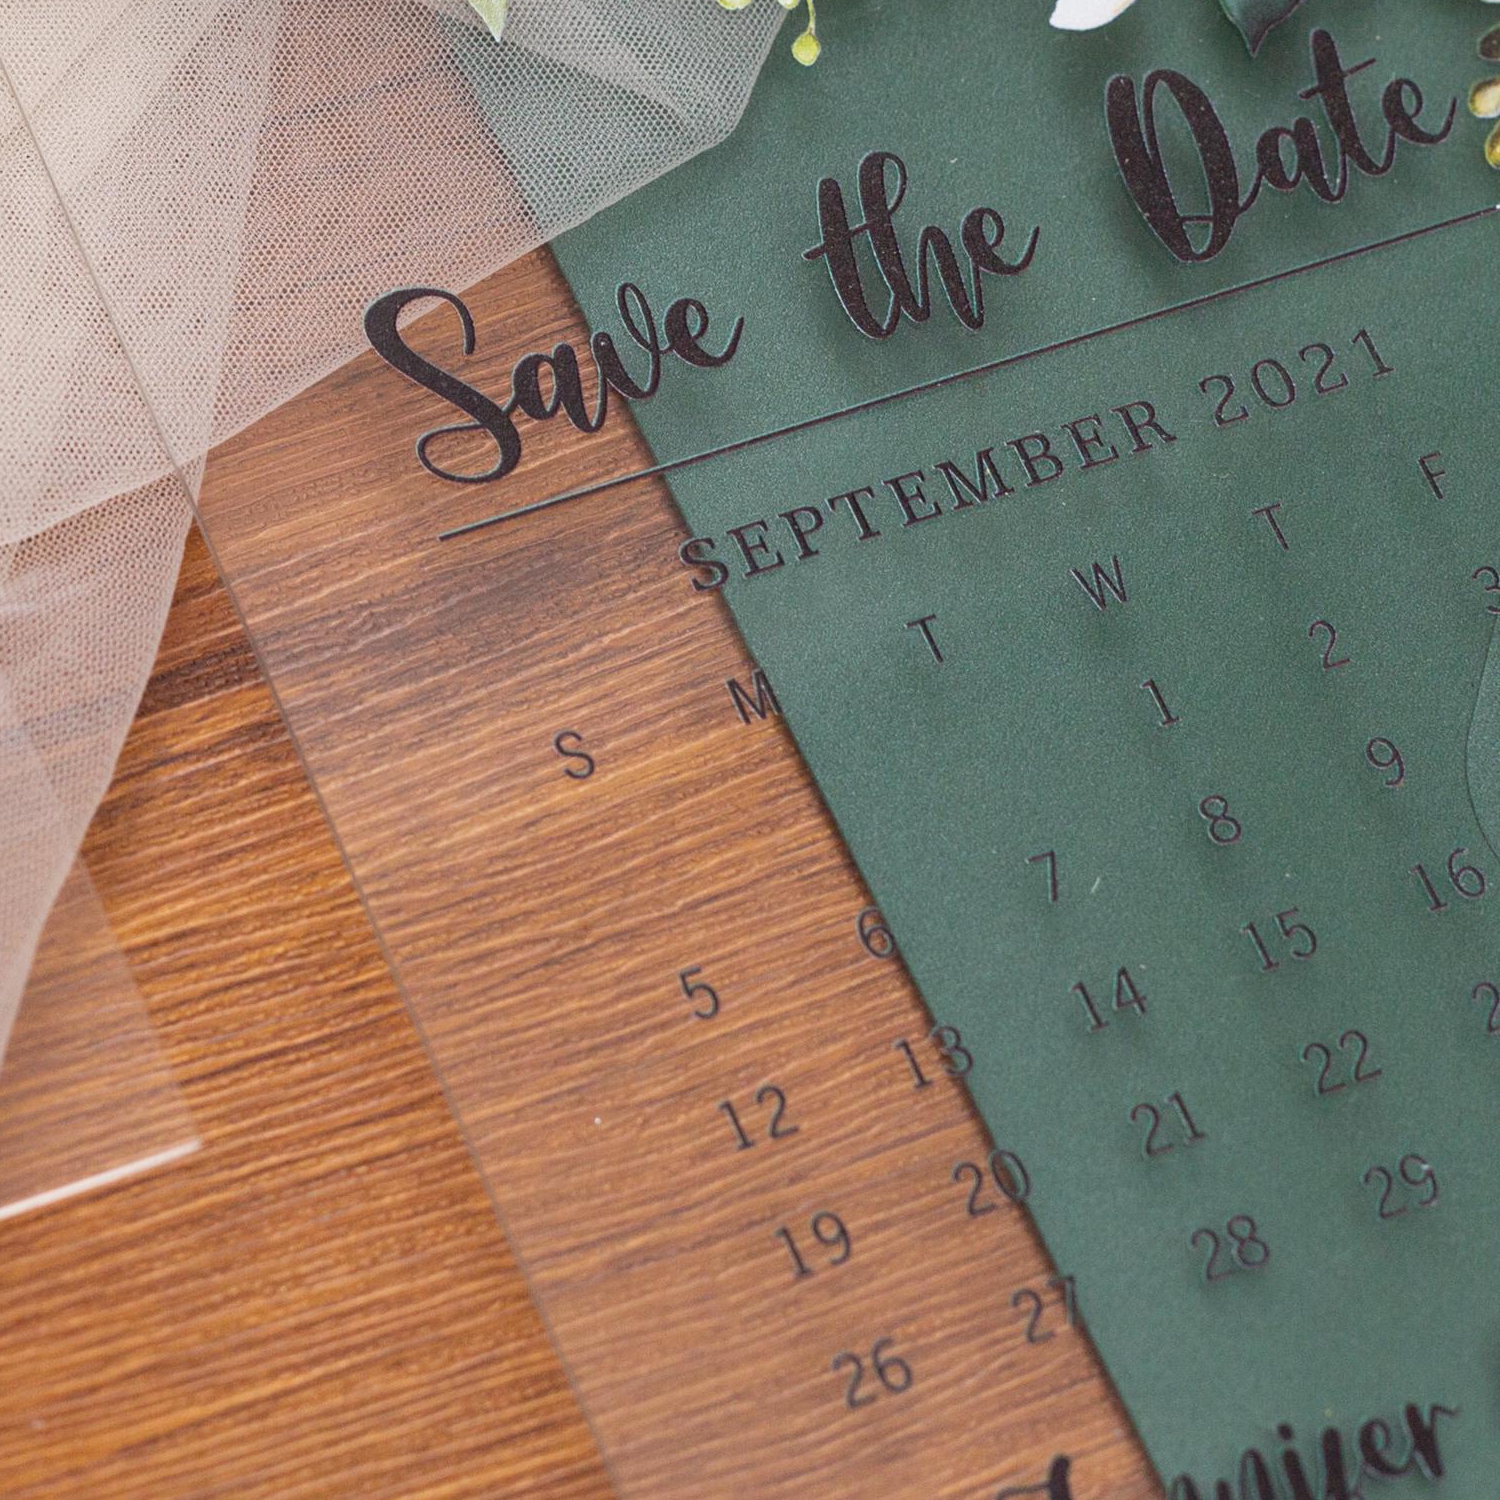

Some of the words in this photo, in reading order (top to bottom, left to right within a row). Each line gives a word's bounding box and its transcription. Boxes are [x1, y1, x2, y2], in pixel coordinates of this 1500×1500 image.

[363, 282, 744, 483] Save
[802, 151, 1040, 340] the
[1105, 27, 1458, 263] Date
[678, 400, 1177, 592] SEPTEMBER
[1199, 326, 1395, 428] 2021
[553, 730, 595, 779] S
[724, 668, 783, 725] M
[905, 614, 944, 664] T
[1069, 554, 1128, 612] W
[1251, 502, 1289, 551] T
[1416, 452, 1447, 500] F
[1140, 678, 1181, 727] 1
[1307, 619, 1350, 672] 2
[677, 967, 720, 1020] 5
[856, 908, 897, 960] 6
[1025, 850, 1059, 902] 7
[1199, 794, 1242, 845] 8
[1366, 736, 1405, 787] 9
[717, 1084, 800, 1151] 12
[894, 1025, 974, 1089] 13
[1071, 966, 1149, 1032] 14
[1242, 907, 1318, 972] 15
[1411, 847, 1487, 912] 16
[773, 1211, 853, 1279] 19
[953, 1149, 1031, 1218] 20
[1129, 1090, 1206, 1156] 21
[1302, 1030, 1383, 1095] 22
[832, 1337, 913, 1409] 26
[1010, 1274, 1079, 1344] 27
[1190, 1214, 1270, 1282] 28
[1362, 1153, 1441, 1221] 29
